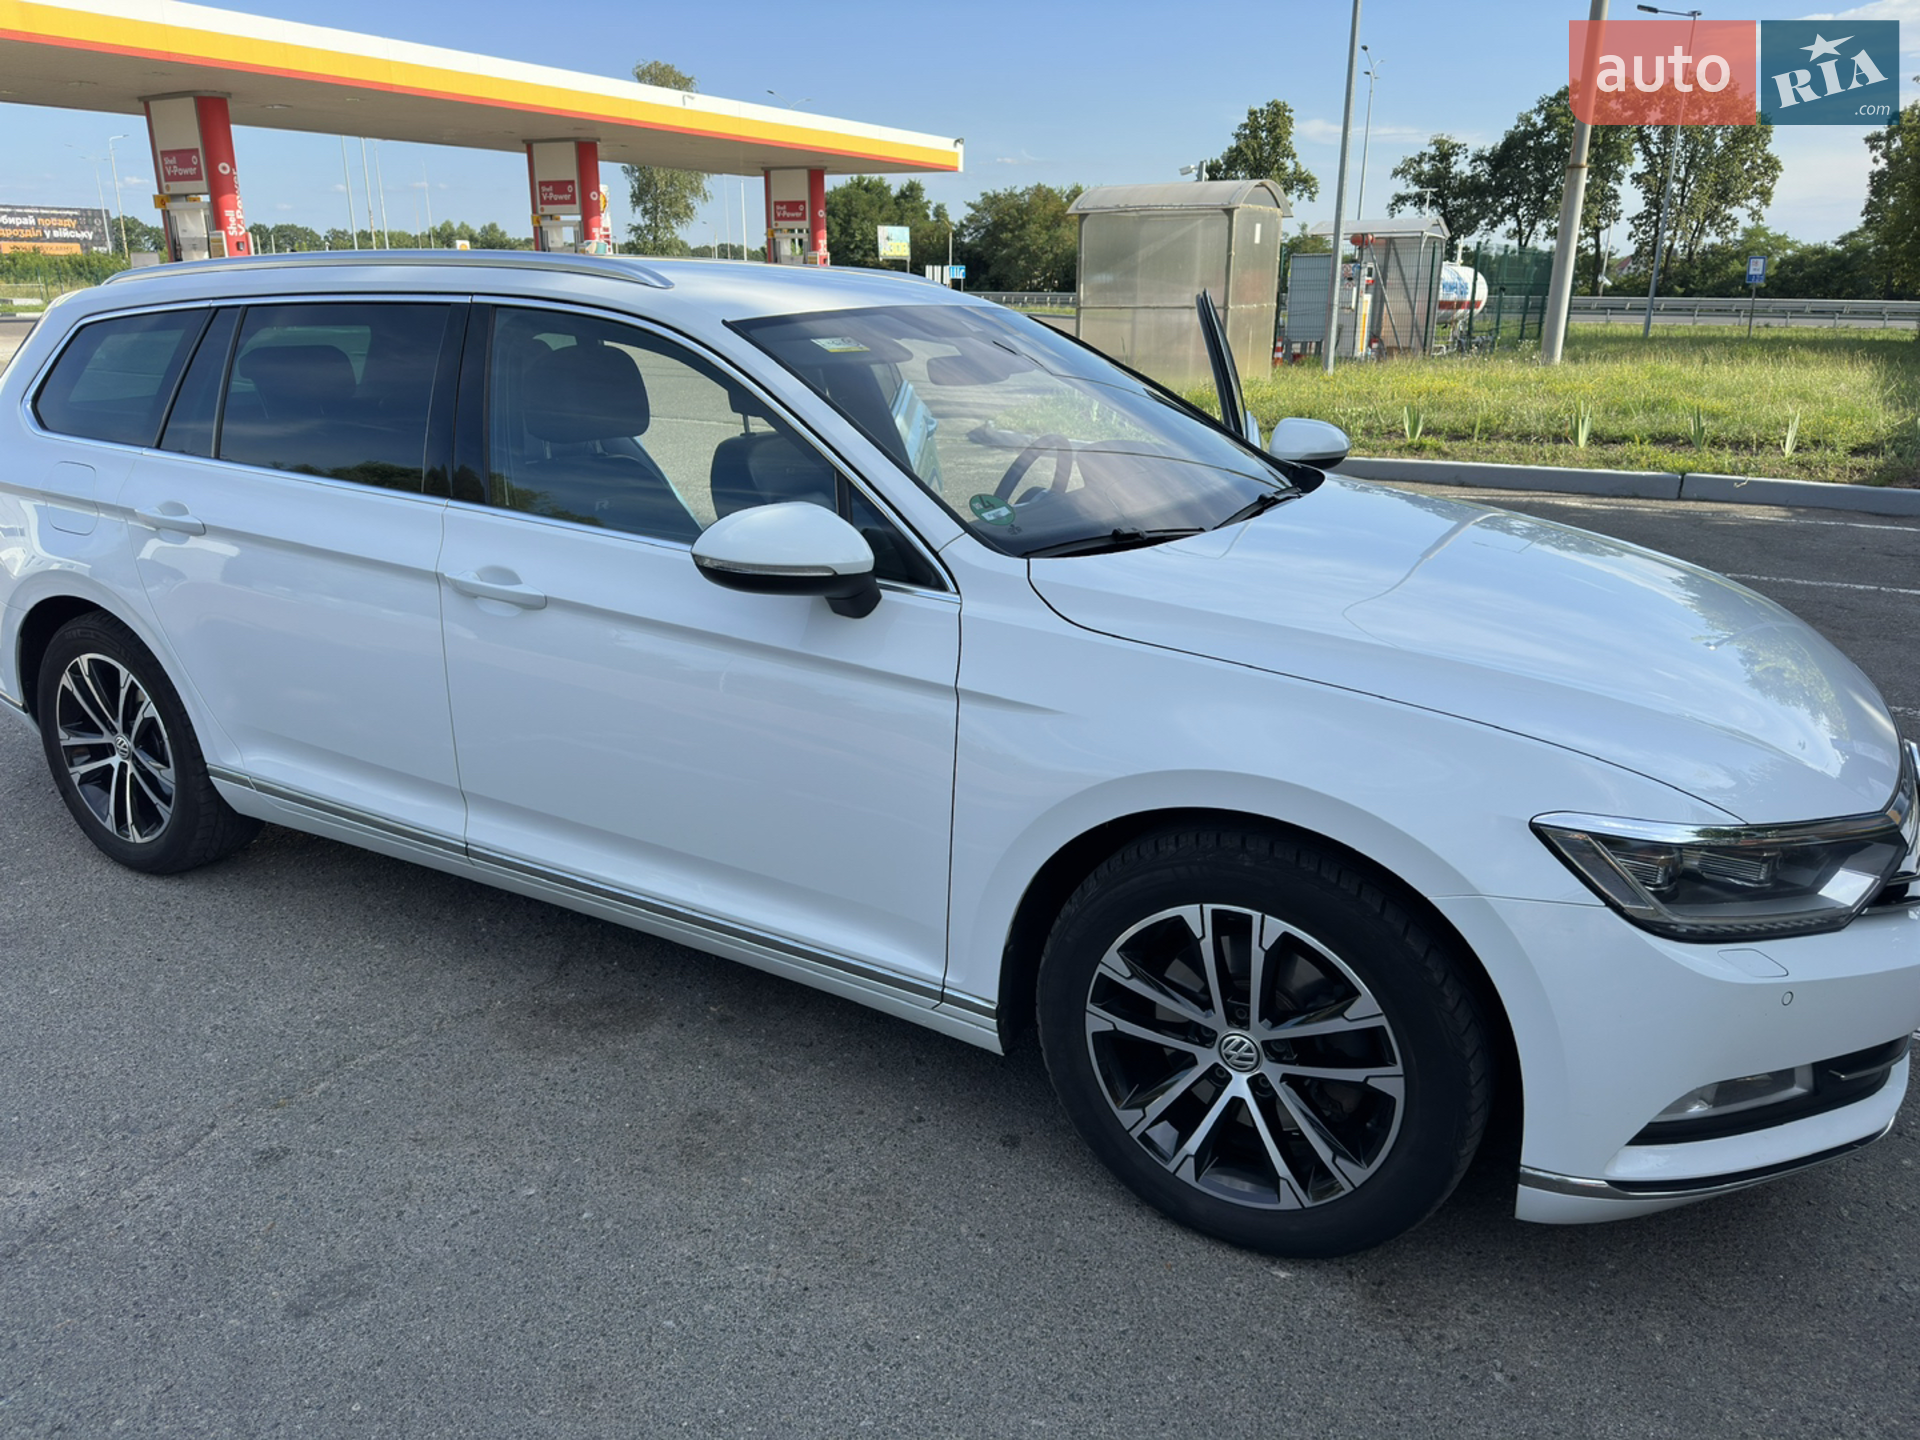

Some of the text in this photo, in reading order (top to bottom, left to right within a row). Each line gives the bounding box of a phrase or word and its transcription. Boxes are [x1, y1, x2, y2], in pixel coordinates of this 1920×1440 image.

[164, 157, 177, 165] Shell
[165, 166, 197, 176] V-Power
[541, 193, 571, 201] V-Power
[0, 214, 36, 226] бирай
[224, 210, 238, 237] Shell
[44, 230, 51, 239] у
